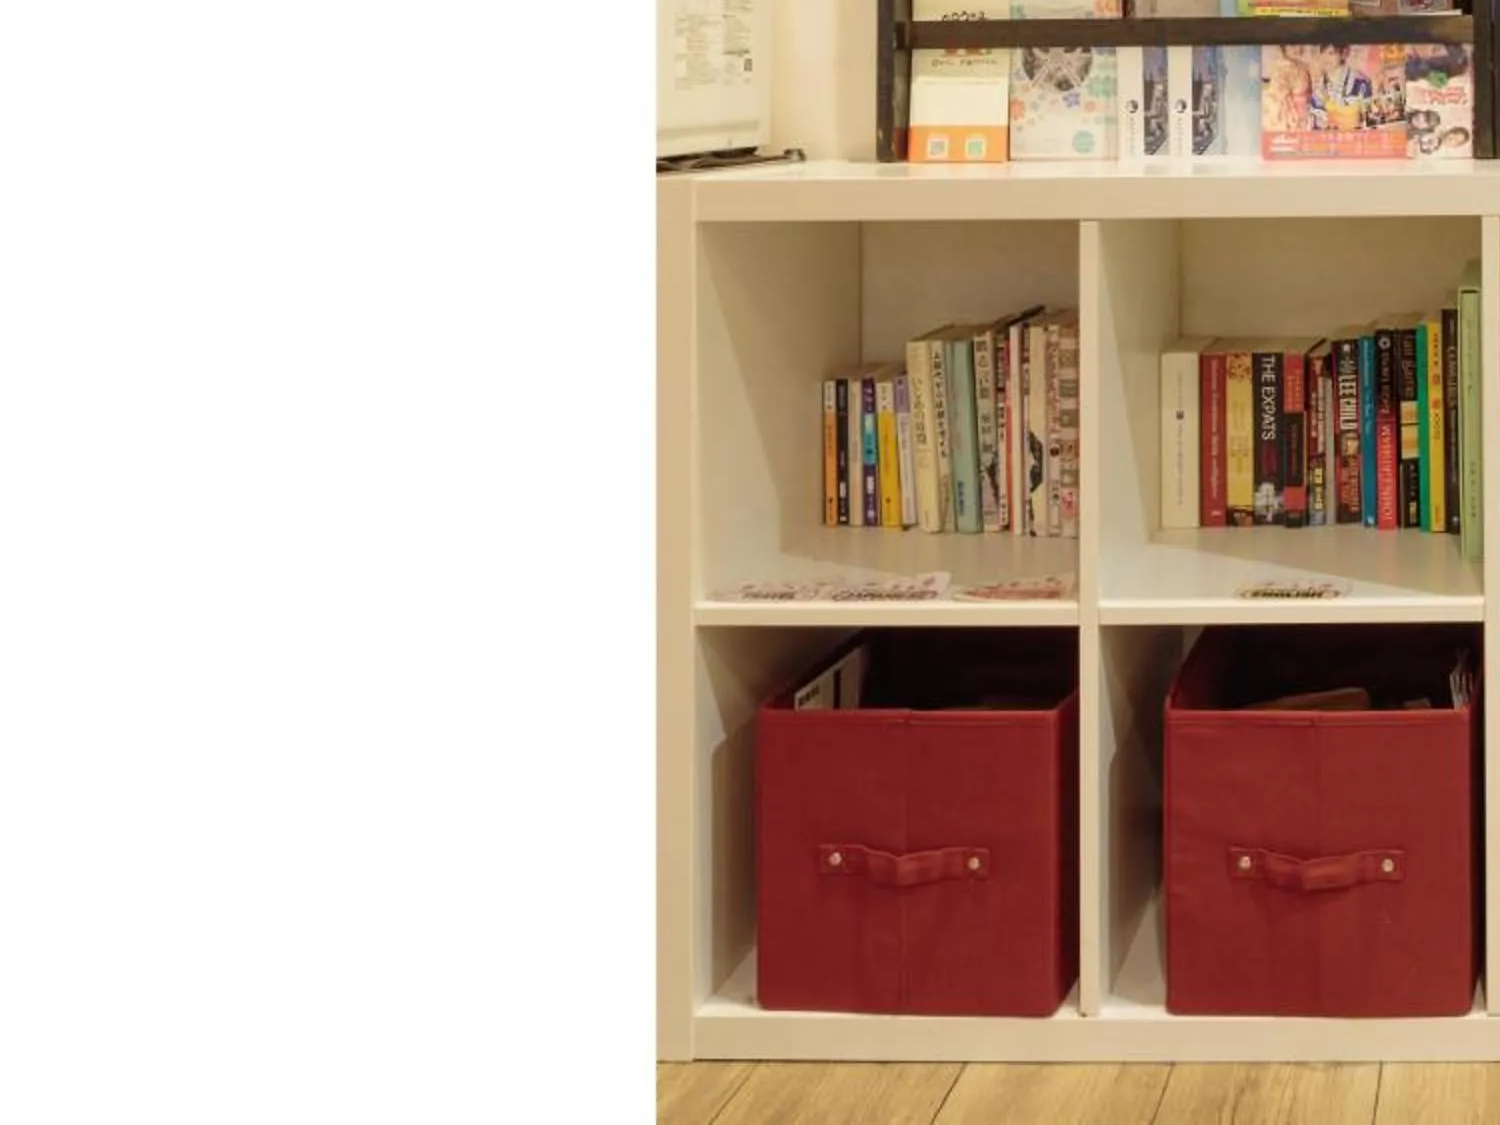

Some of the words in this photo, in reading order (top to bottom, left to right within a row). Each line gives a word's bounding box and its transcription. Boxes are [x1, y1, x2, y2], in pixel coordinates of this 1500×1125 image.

[1261, 356, 1276, 382] THE
[1339, 374, 1357, 396] LEE
[1261, 387, 1277, 441] EXPATS
